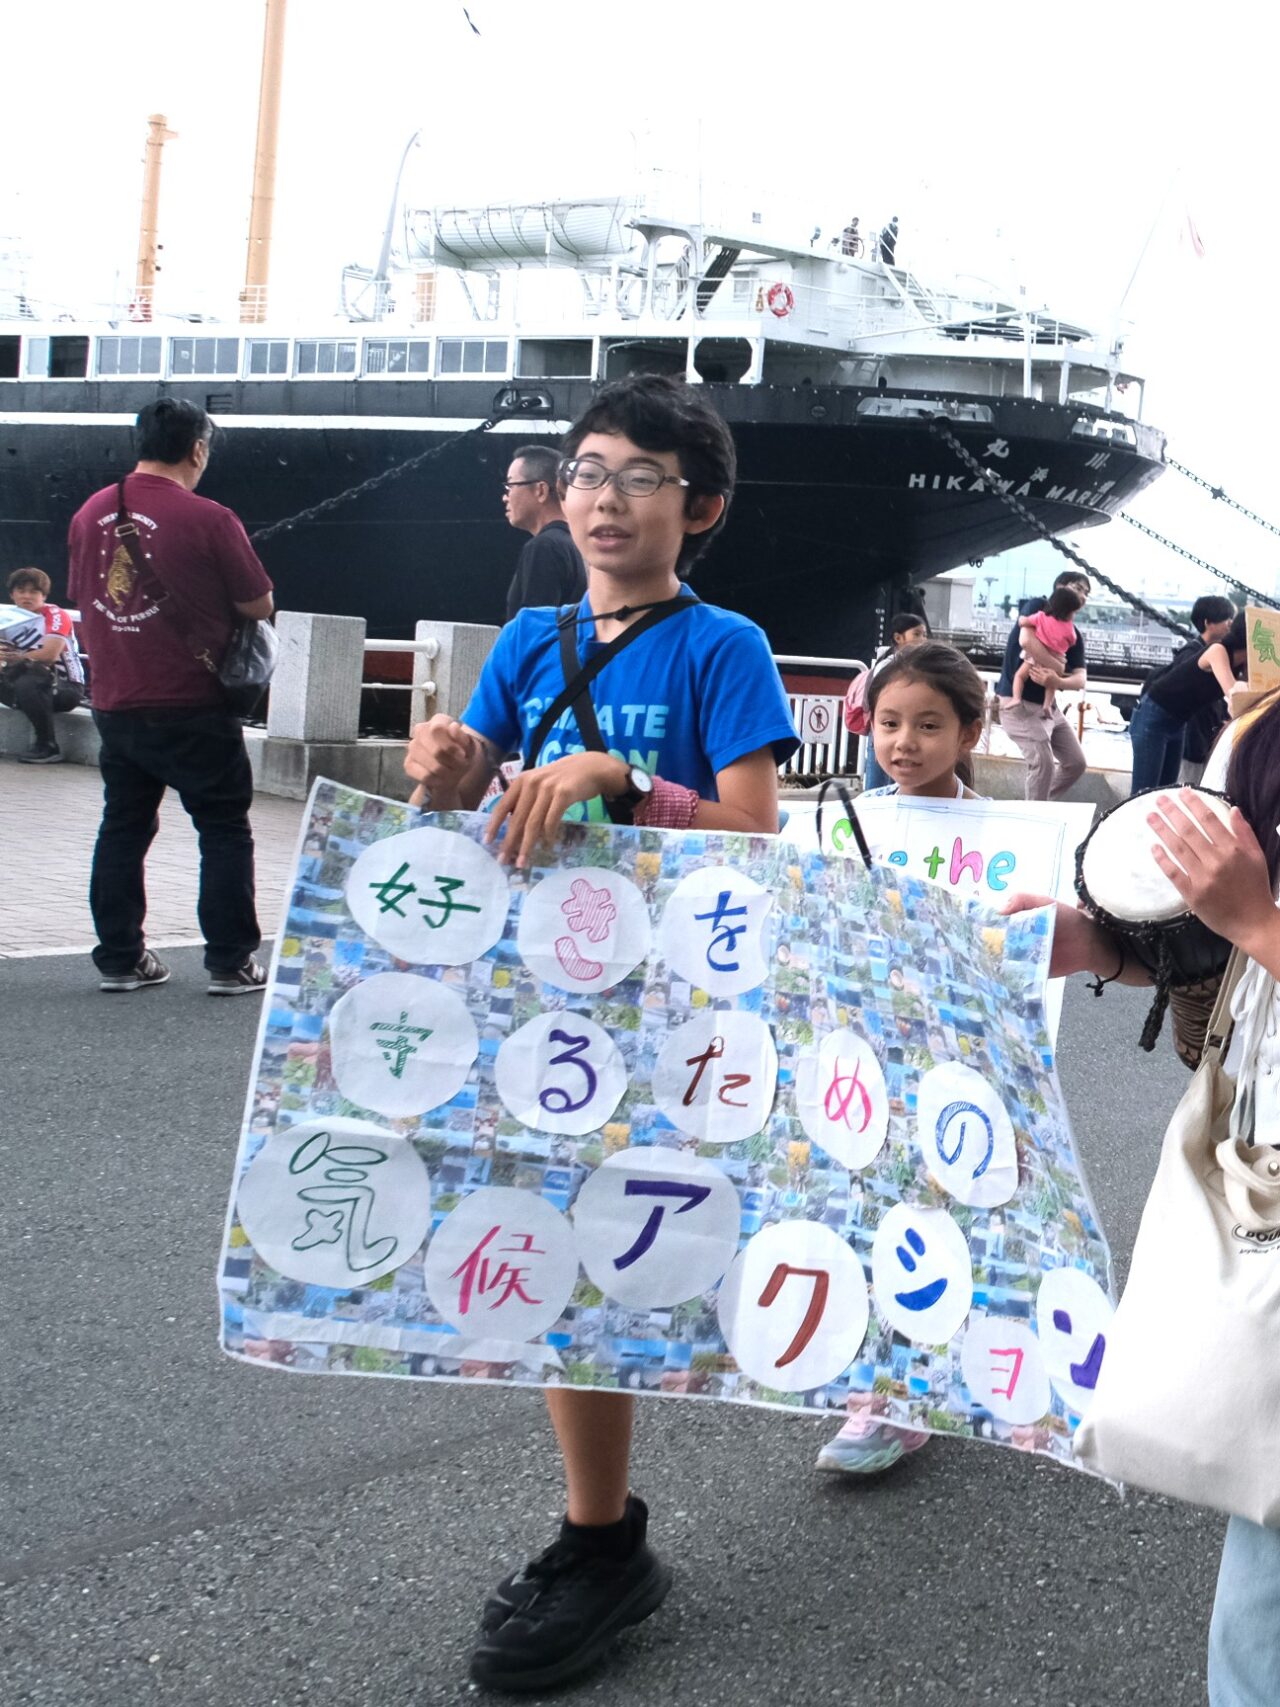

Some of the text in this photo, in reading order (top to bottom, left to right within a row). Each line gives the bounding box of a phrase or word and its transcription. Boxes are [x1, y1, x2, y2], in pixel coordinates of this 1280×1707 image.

[908, 473, 1031, 496] HIKAWA
[1045, 485, 1104, 506] MARU
[923, 836, 1016, 891] the
